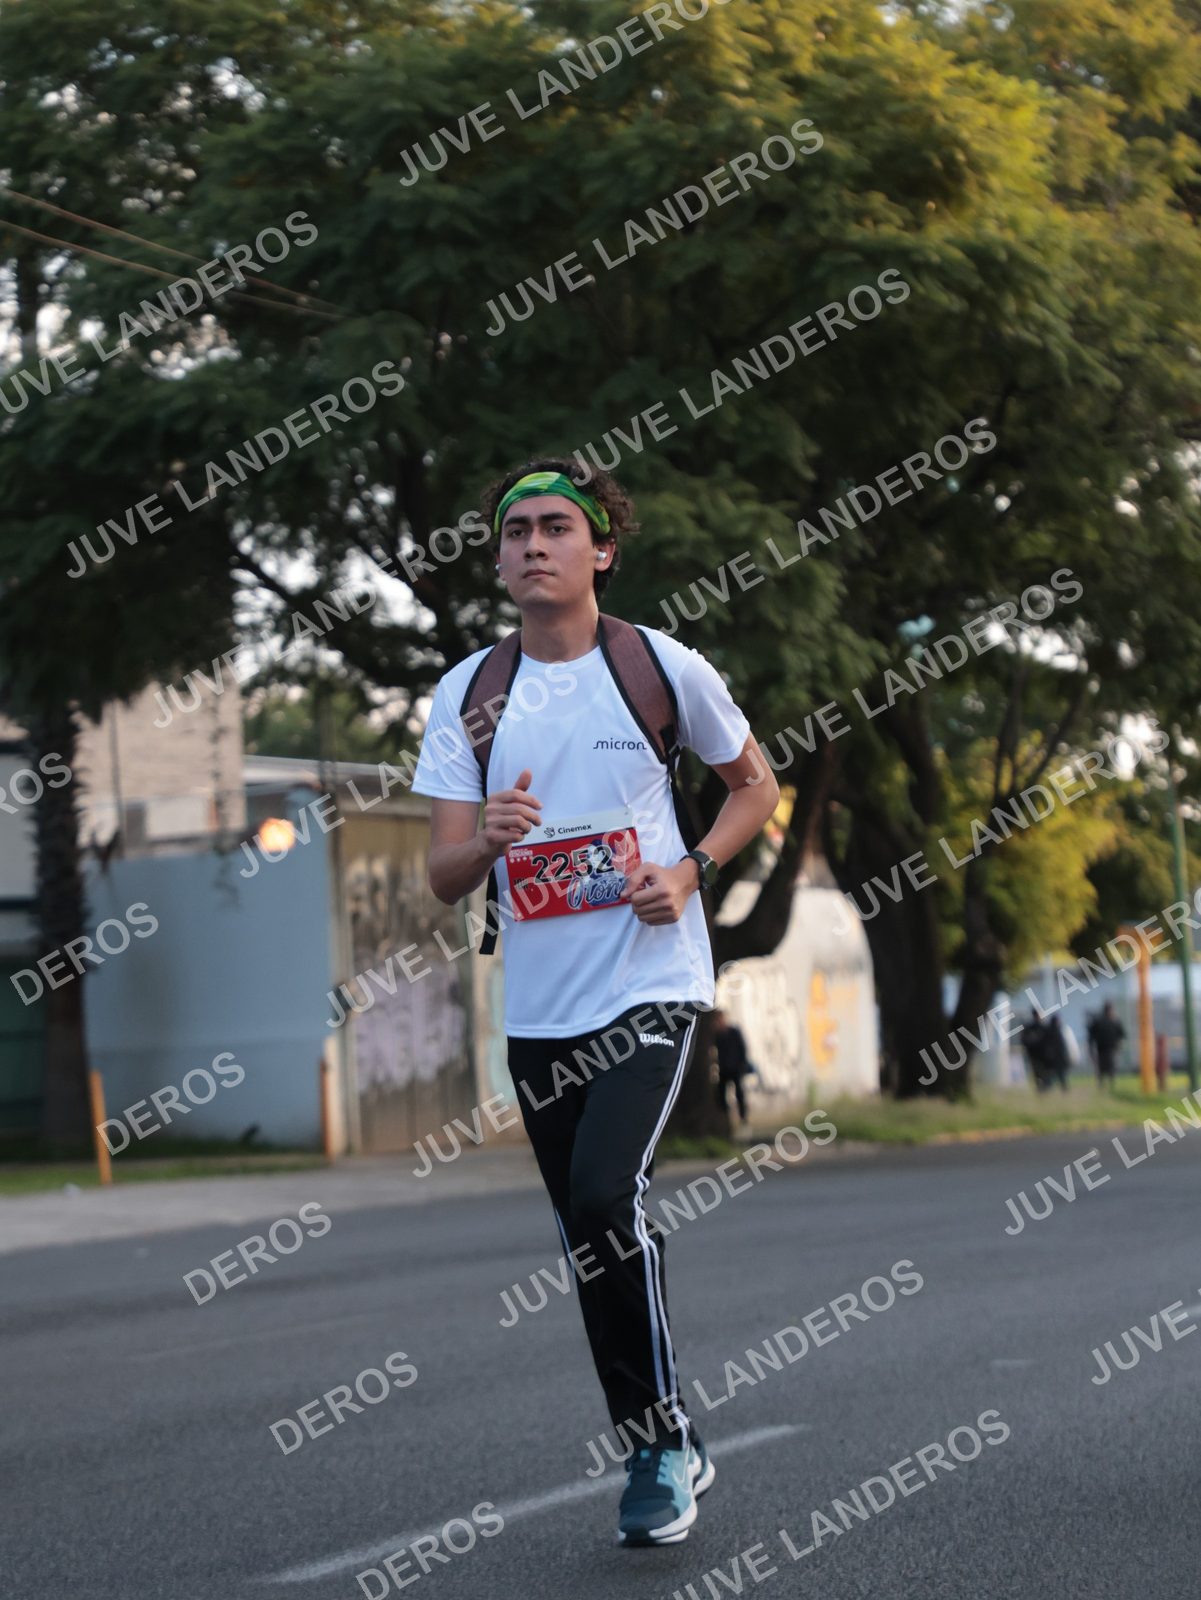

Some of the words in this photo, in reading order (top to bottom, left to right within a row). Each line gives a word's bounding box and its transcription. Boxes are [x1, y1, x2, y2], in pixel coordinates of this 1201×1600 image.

[593, 738, 647, 750] micron
[558, 823, 592, 835] Cinemex
[531, 845, 615, 884] 2252
[639, 1034, 674, 1047] Wilson
